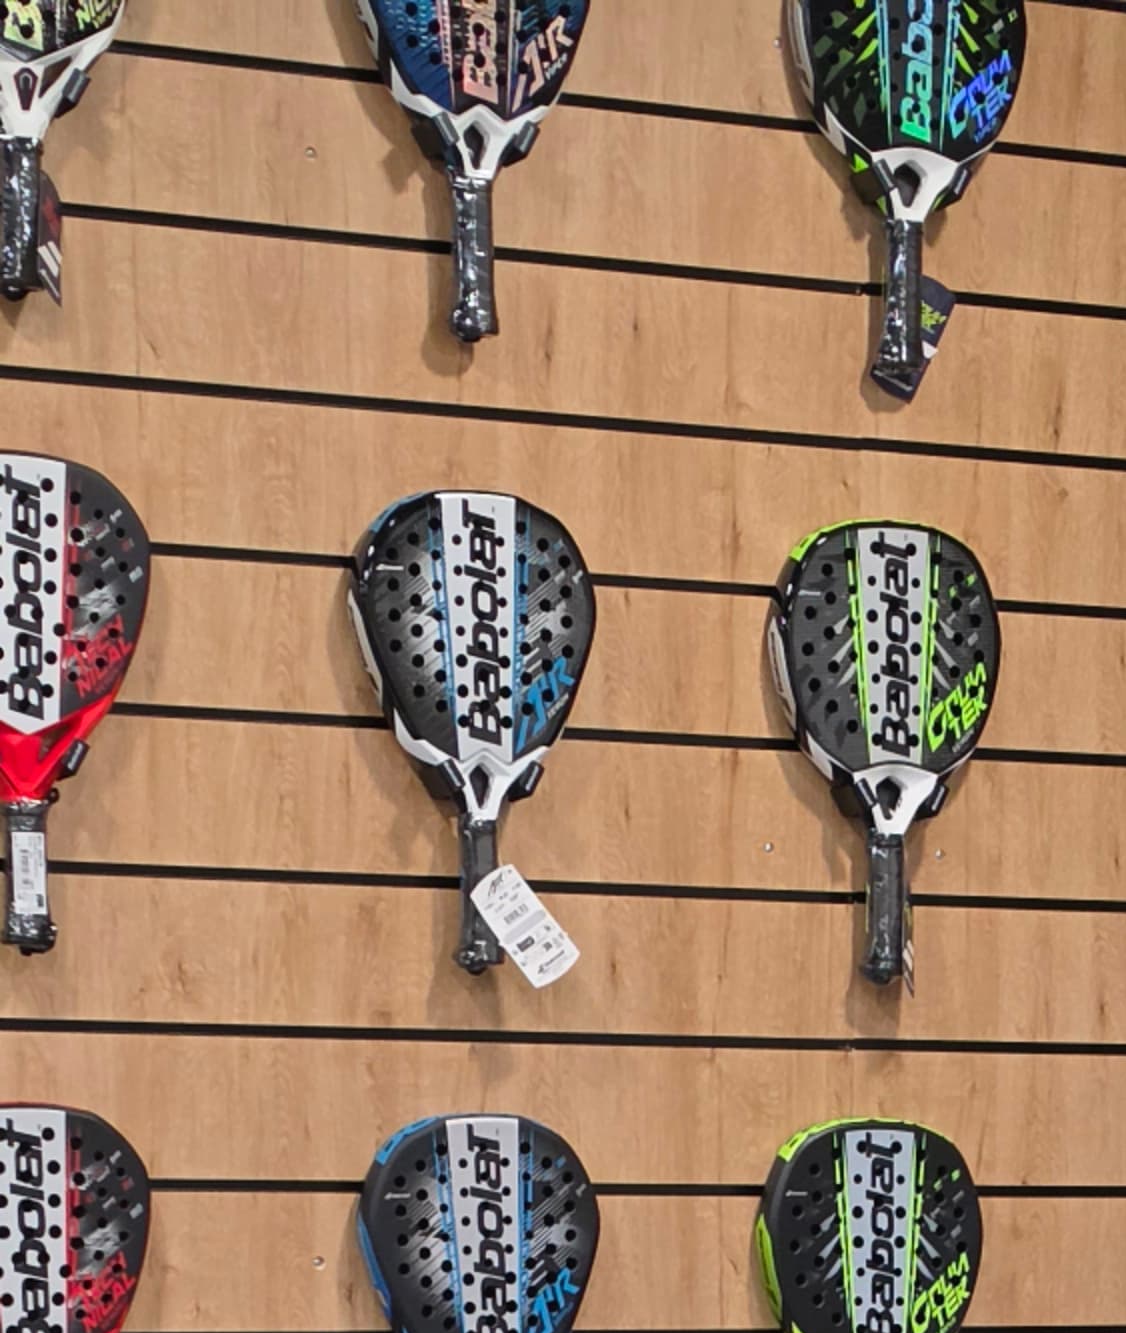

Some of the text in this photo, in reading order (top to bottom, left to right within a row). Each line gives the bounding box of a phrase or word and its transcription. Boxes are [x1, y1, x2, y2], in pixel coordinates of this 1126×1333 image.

[900, 0, 933, 143] Babo
[4, 463, 44, 720] Babolat
[461, 498, 503, 746] Babolat
[878, 531, 911, 758] Babolat
